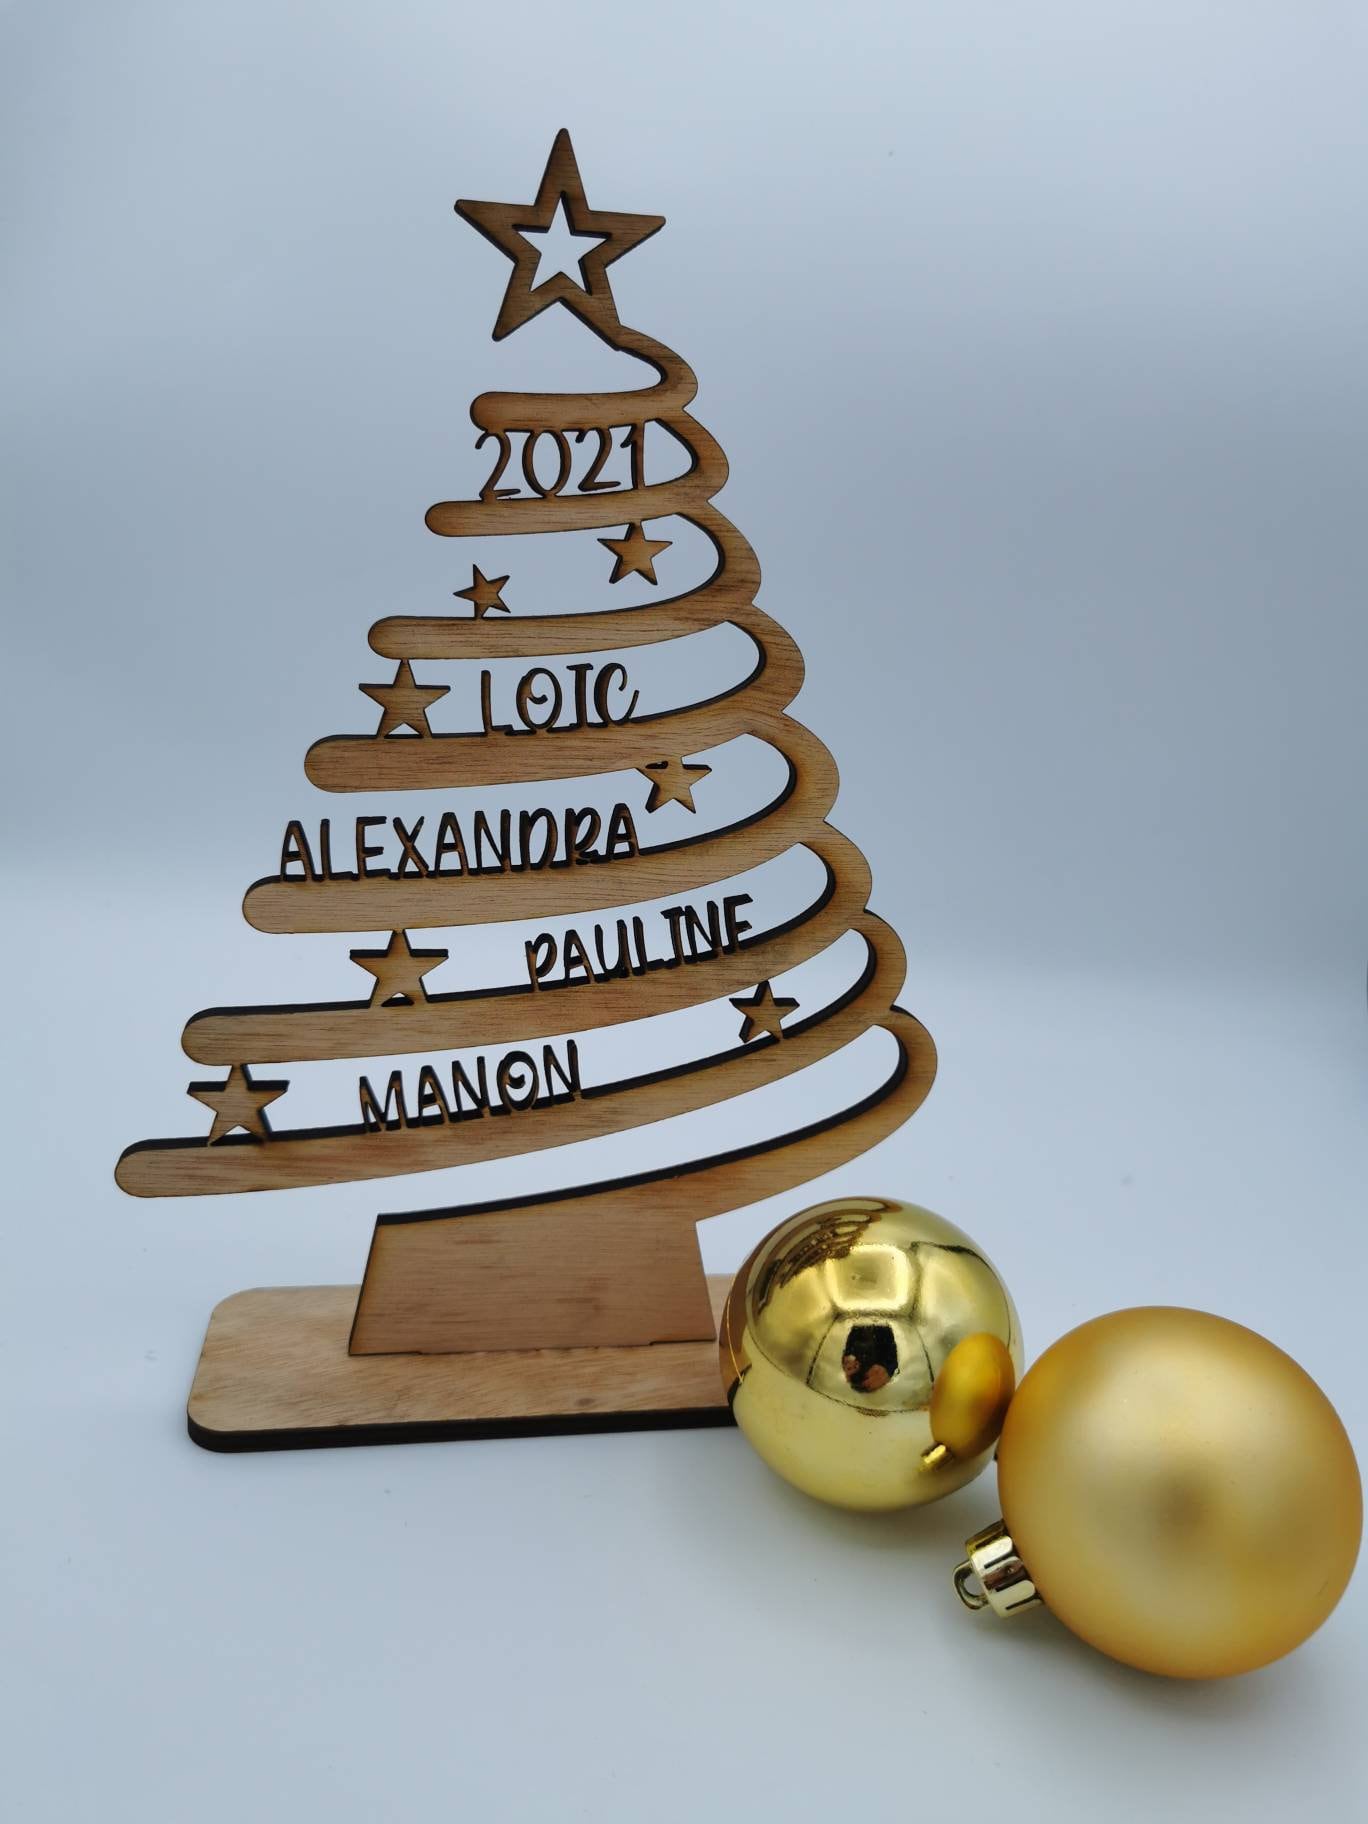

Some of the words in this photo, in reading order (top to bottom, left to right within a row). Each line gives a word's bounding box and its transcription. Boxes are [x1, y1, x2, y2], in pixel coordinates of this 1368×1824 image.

[475, 422, 646, 500] 2021
[480, 662, 640, 736] LOIC
[279, 803, 642, 881] ALEXANDRA
[525, 893, 754, 991] PAULINE
[359, 1039, 582, 1131] MANON
